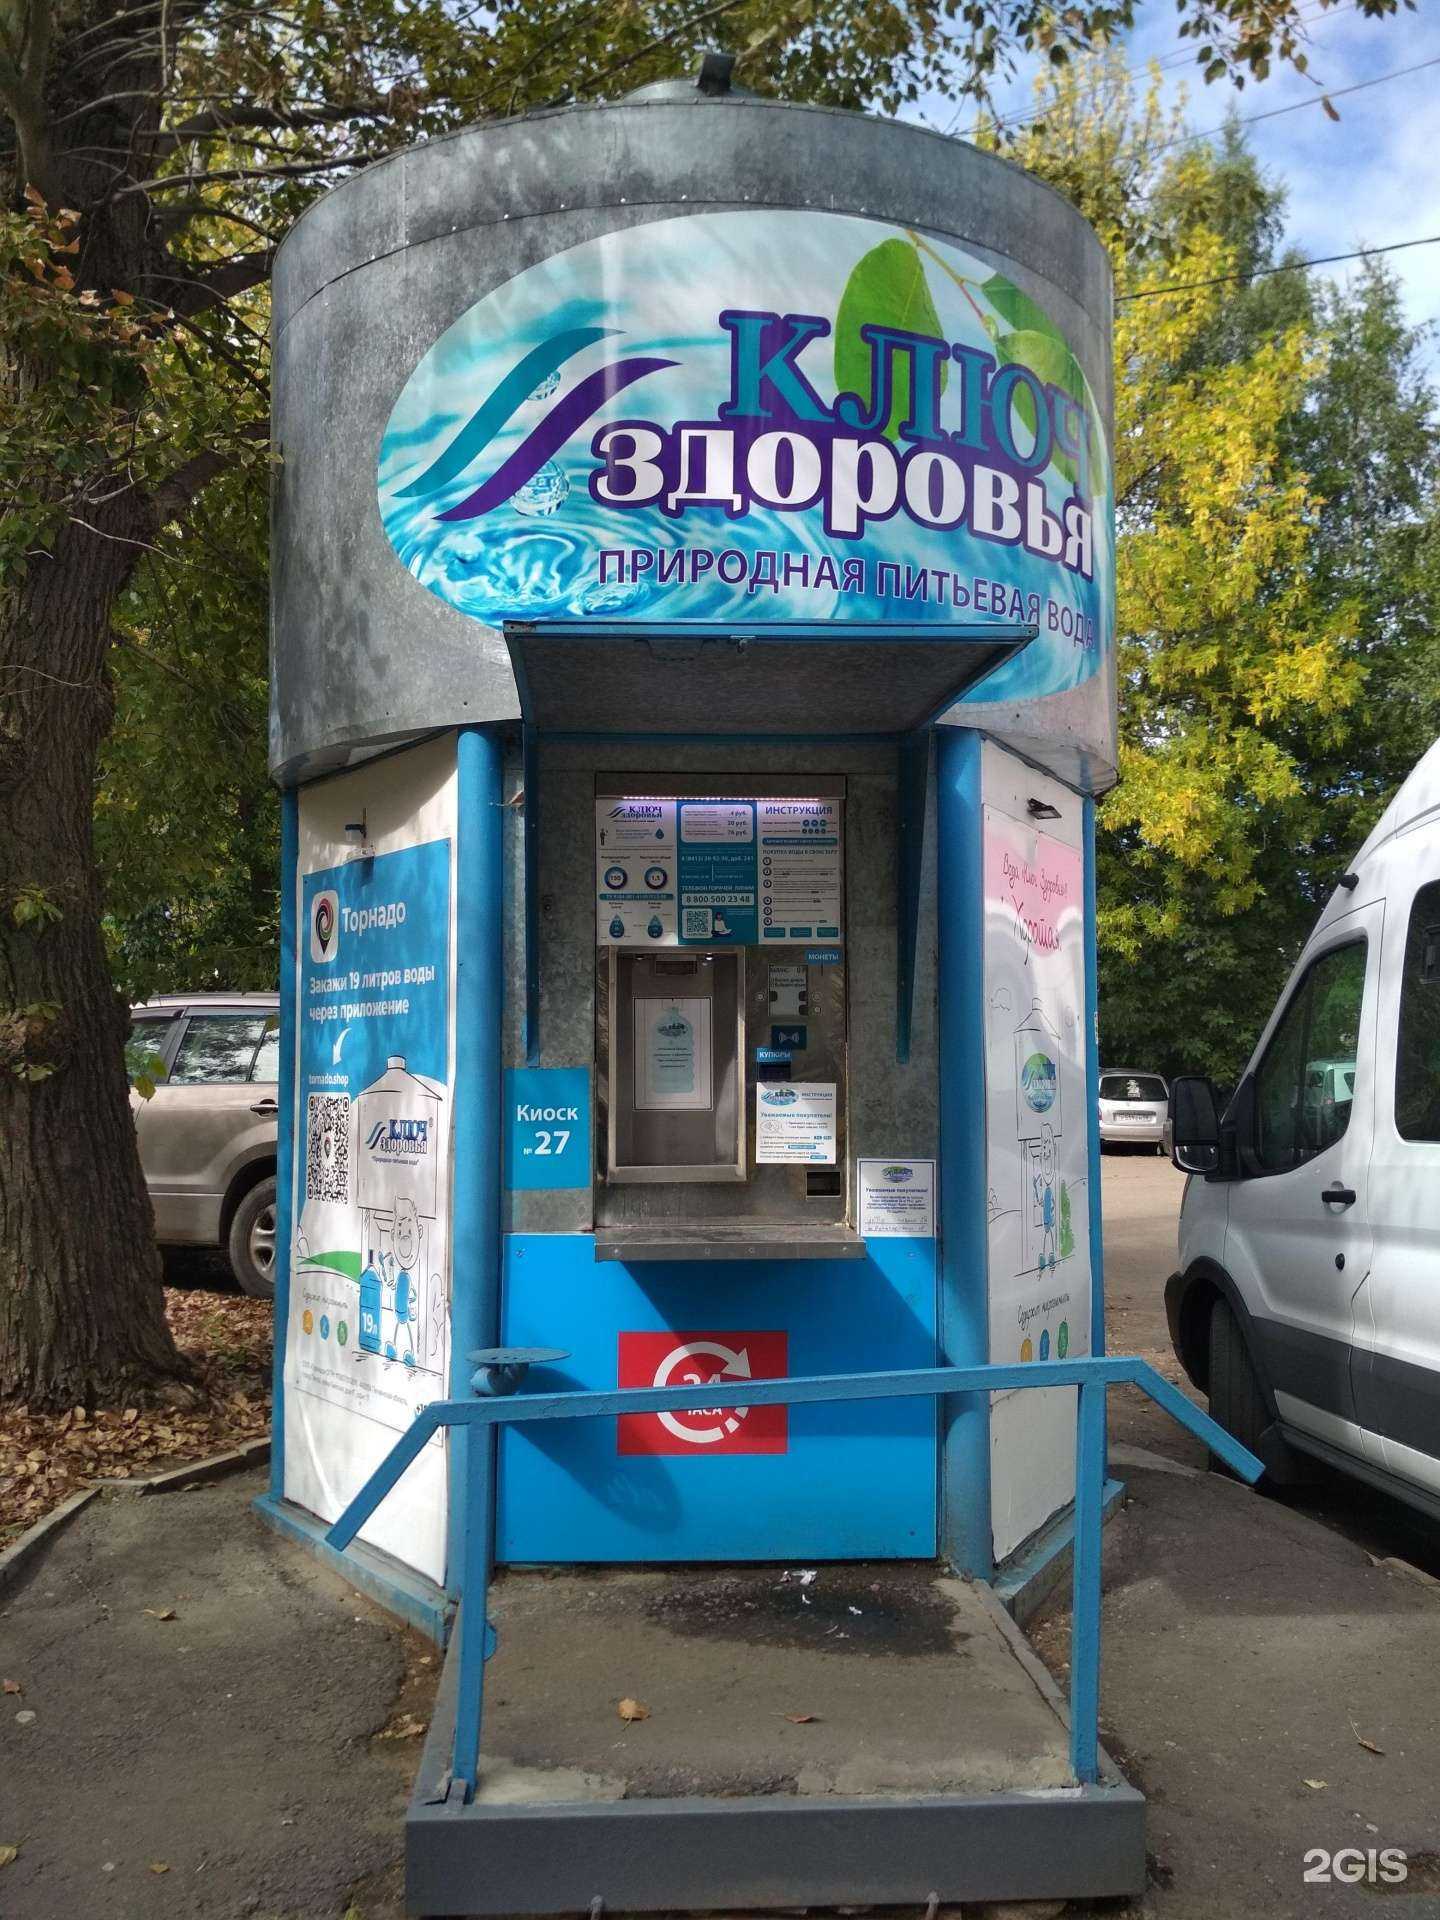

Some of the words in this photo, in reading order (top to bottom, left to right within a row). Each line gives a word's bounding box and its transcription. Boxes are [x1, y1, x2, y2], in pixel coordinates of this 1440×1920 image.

[720, 310, 1097, 505] КЛЮЧ
[591, 421, 1095, 582] здоровья
[599, 549, 865, 594] ПРИРОДНАЯ
[877, 561, 1041, 626] ПИТЬЕВАЯ
[1047, 599, 1094, 649] ВОДА
[765, 806, 833, 816] ИНСТРУКЦИЯ
[686, 895, 691, 904] 8
[693, 895, 709, 904] 800
[710, 895, 726, 904] 500
[727, 895, 738, 904] 23
[342, 902, 406, 937] Торнадо
[808, 953, 839, 961] МОНЕТЫ
[309, 976, 348, 995] Закажи
[349, 971, 360, 990] 19
[361, 968, 402, 991] литров
[403, 965, 435, 985] воды
[309, 1006, 338, 1025] через
[340, 998, 410, 1023] приложение
[308, 1072, 350, 1087] tornado.shop
[516, 1104, 580, 1122] Киоск
[388, 1118, 428, 1140] КЛЮЧ
[380, 1135, 428, 1156] здоровья
